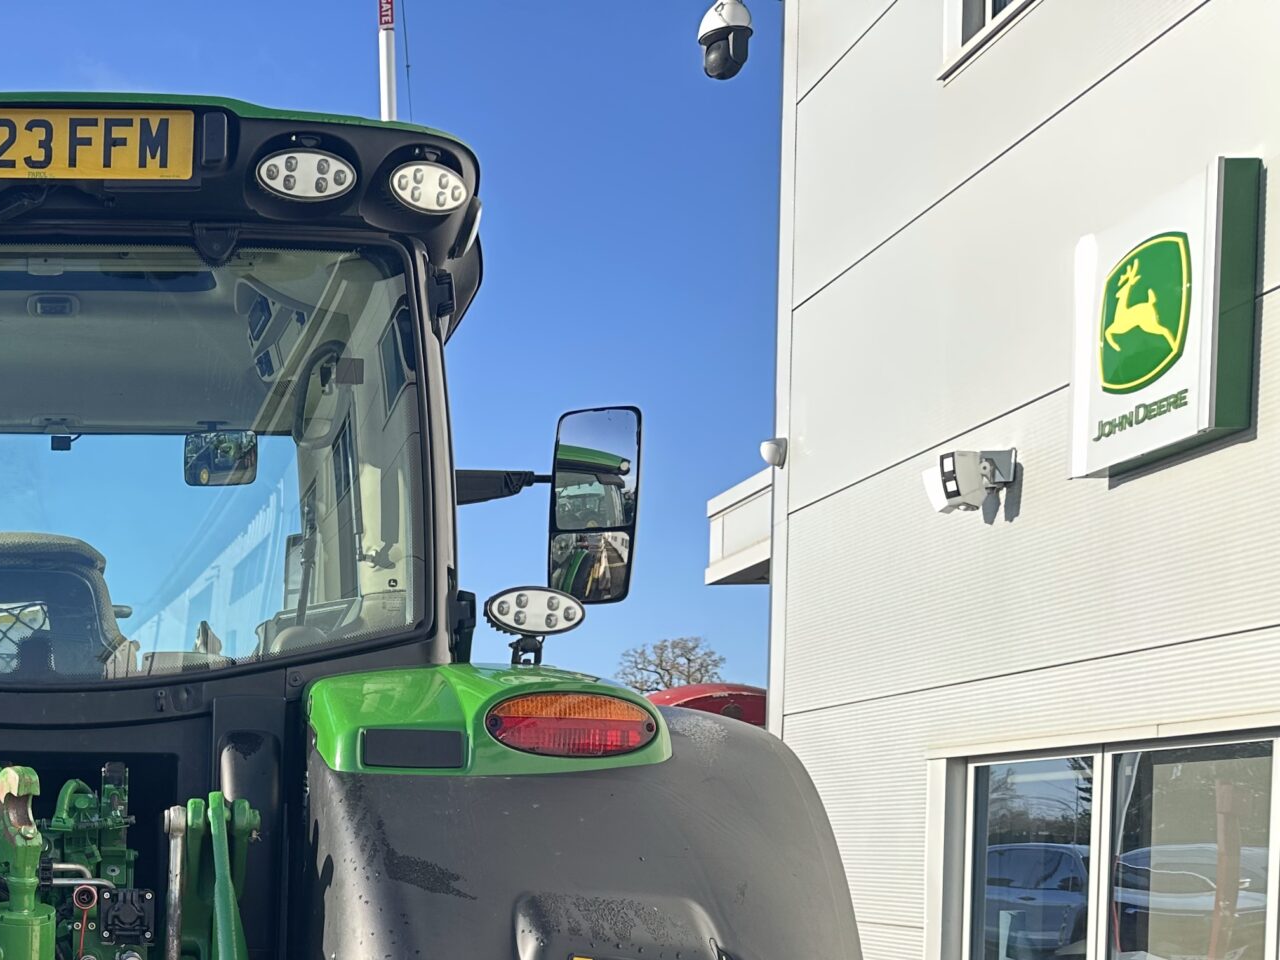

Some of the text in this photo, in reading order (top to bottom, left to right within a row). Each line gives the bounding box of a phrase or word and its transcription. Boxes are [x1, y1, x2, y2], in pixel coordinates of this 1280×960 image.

[68, 117, 170, 169] FFM
[1092, 388, 1189, 442] JOHN DEERE
